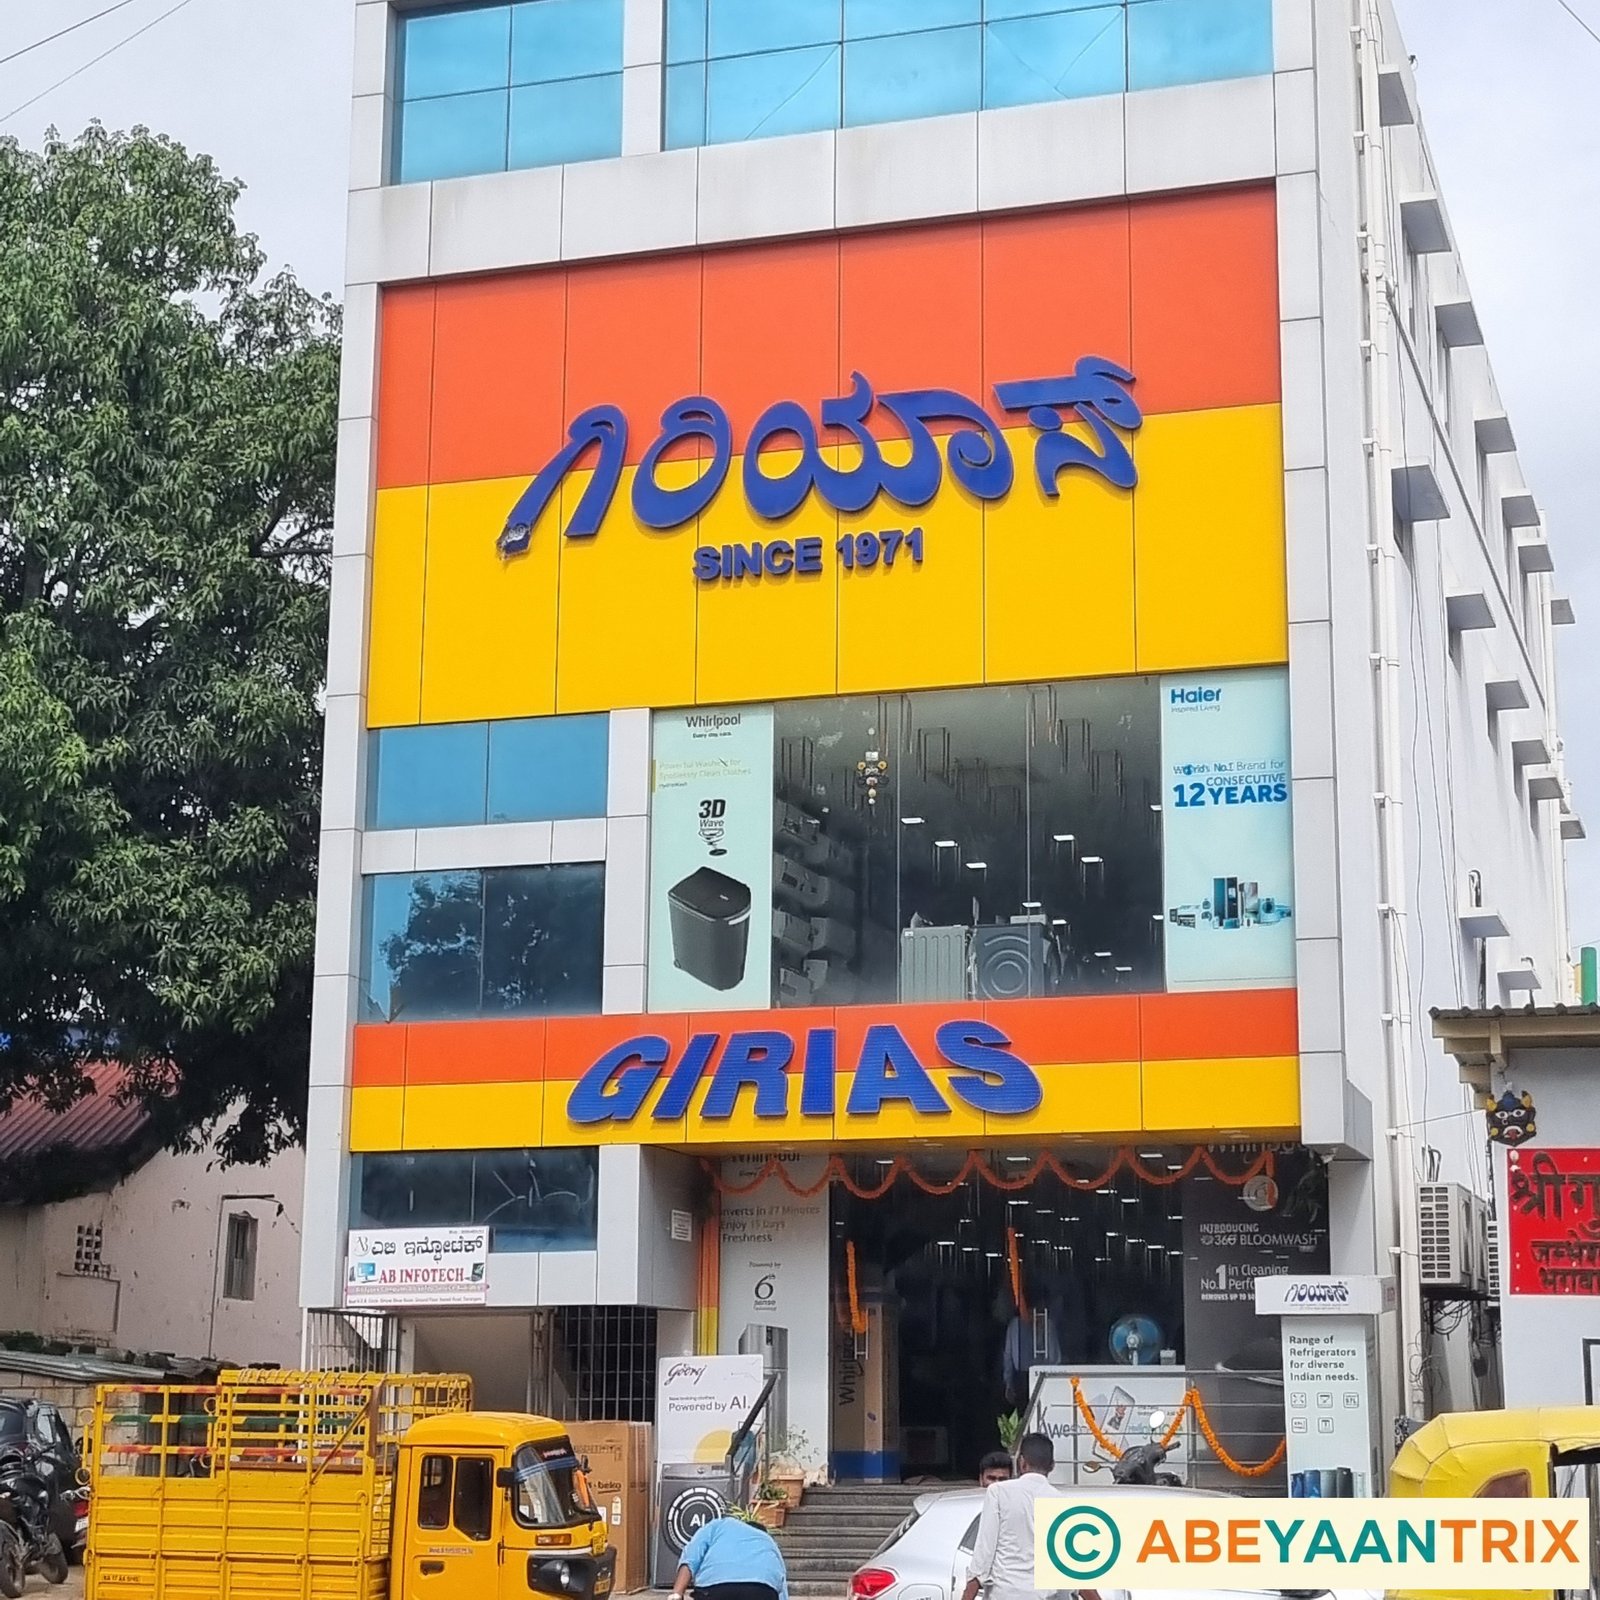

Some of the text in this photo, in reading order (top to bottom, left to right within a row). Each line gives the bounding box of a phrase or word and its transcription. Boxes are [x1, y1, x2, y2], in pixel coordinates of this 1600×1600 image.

[496, 355, 1143, 559] ಗಿರಿಯಾಸ್
[692, 527, 925, 581] SINCE 1971
[1170, 686, 1222, 704] Haier
[685, 713, 741, 730] Whirlpool
[1236, 760, 1266, 771] Brand
[1270, 759, 1285, 769] for
[1206, 773, 1287, 787] CONSECUTIVE
[1172, 782, 1288, 808] 12 YEARS
[698, 798, 726, 819] 3D
[699, 819, 725, 828] Wave
[566, 1019, 1043, 1124] GIRIAS
[722, 1233, 773, 1243] Freshness
[1239, 1233, 1318, 1246] BLOOMWASH
[379, 1267, 465, 1284] AB INFOTECH
[1241, 1263, 1289, 1276] Cleaning
[1289, 1335, 1334, 1346] Range of
[1289, 1347, 1357, 1358] Refrigerators
[1289, 1359, 1345, 1369] for diverse
[1290, 1371, 1359, 1381] Indian needs.
[668, 1401, 713, 1412] Powered
[714, 1401, 727, 1412] by
[597, 1481, 622, 1492] beko
[689, 1513, 706, 1528] AI
